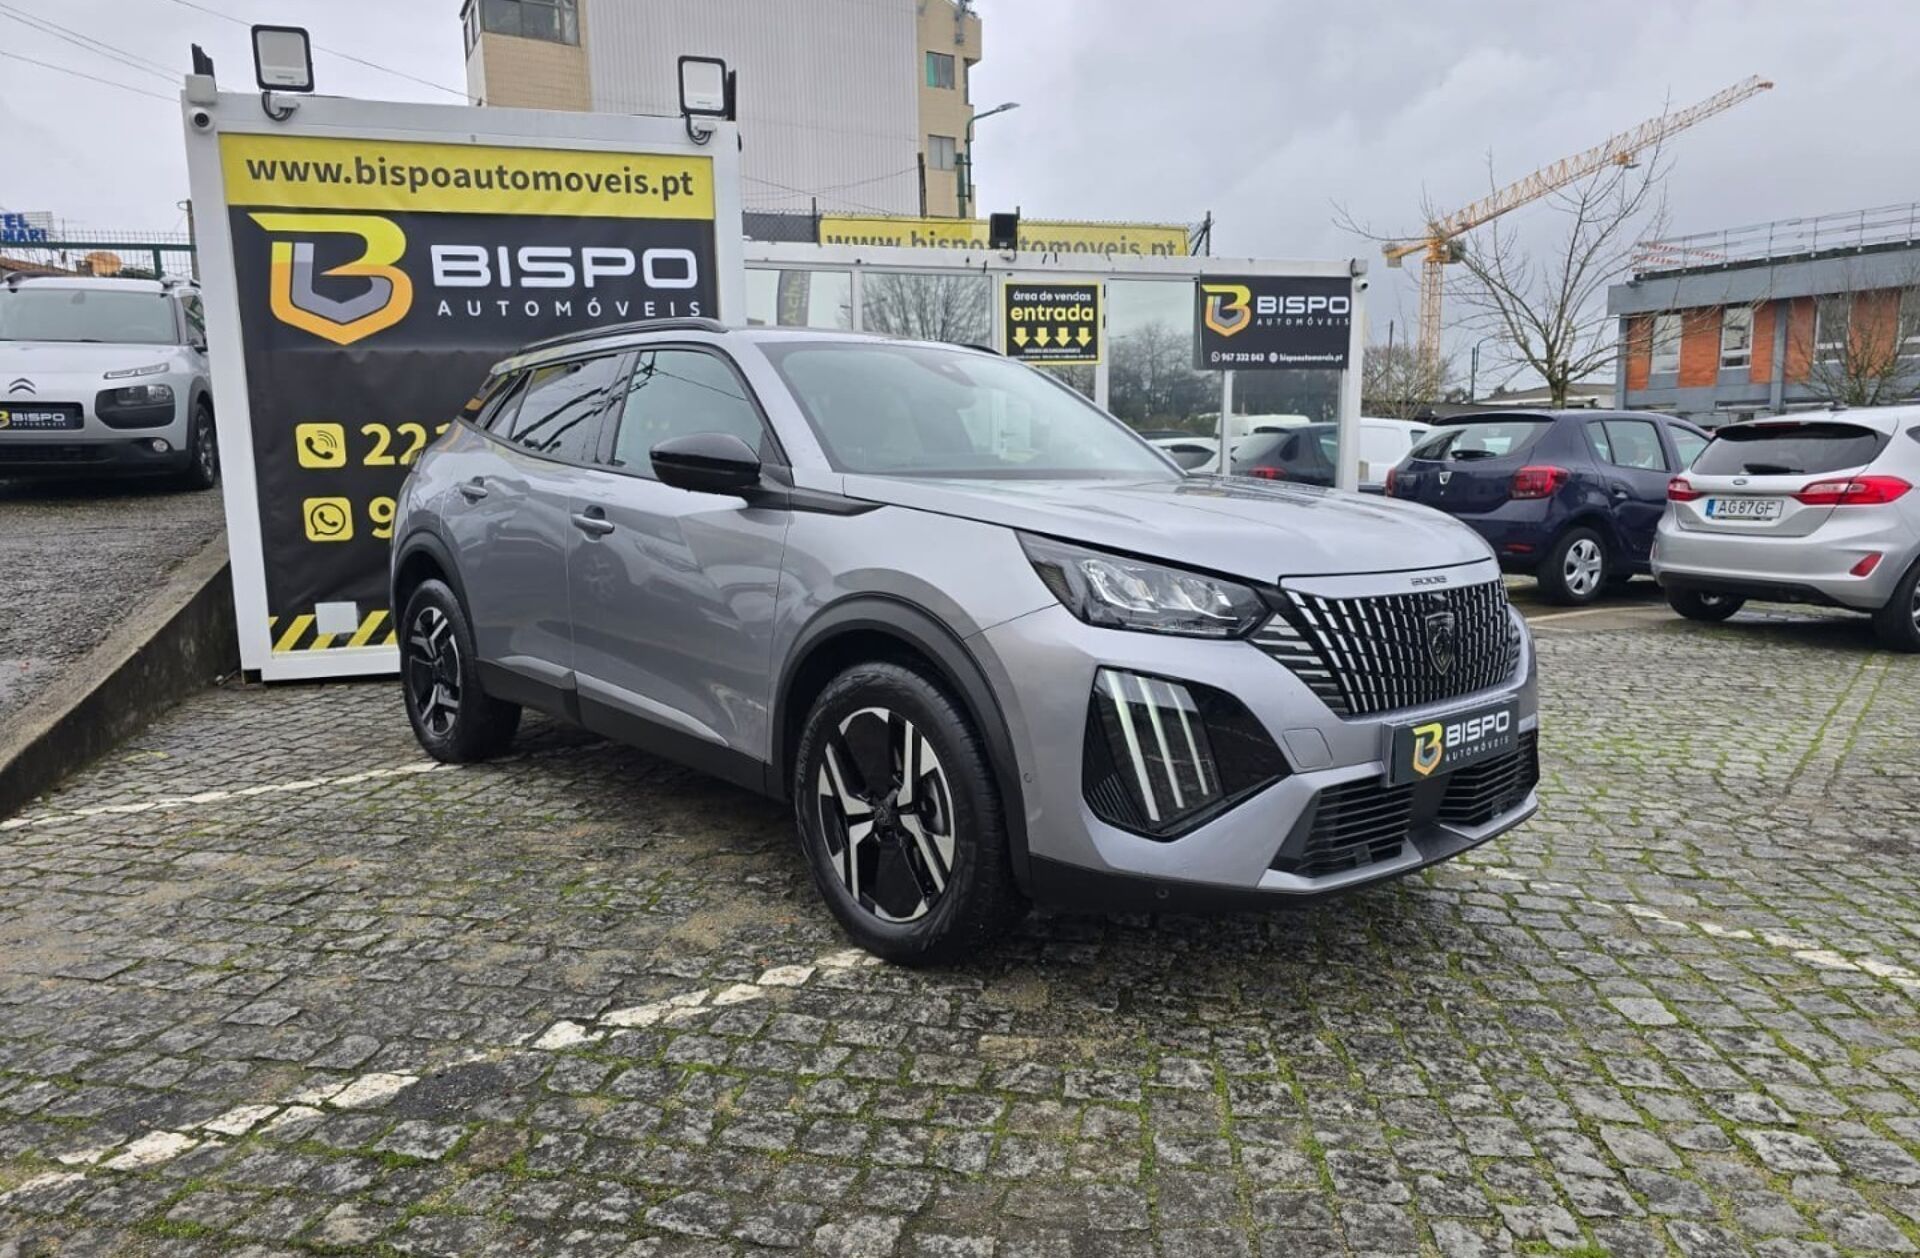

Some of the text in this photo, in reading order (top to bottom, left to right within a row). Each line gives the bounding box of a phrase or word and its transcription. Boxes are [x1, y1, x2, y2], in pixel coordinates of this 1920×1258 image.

[247, 155, 694, 202] www.bispoautomoveis.pt
[0, 213, 30, 230] EL
[430, 244, 699, 289] BISPO
[1013, 290, 1092, 301] área de vendas
[438, 297, 701, 317] AUTOMÓVEIS
[1010, 303, 1094, 321] entrada
[1257, 296, 1350, 314] BISPO
[1256, 316, 1350, 326] AUTOMÓVEIS
[11, 412, 65, 422] BISPO
[360, 423, 451, 466] 22
[1445, 710, 1510, 748] BISPO
